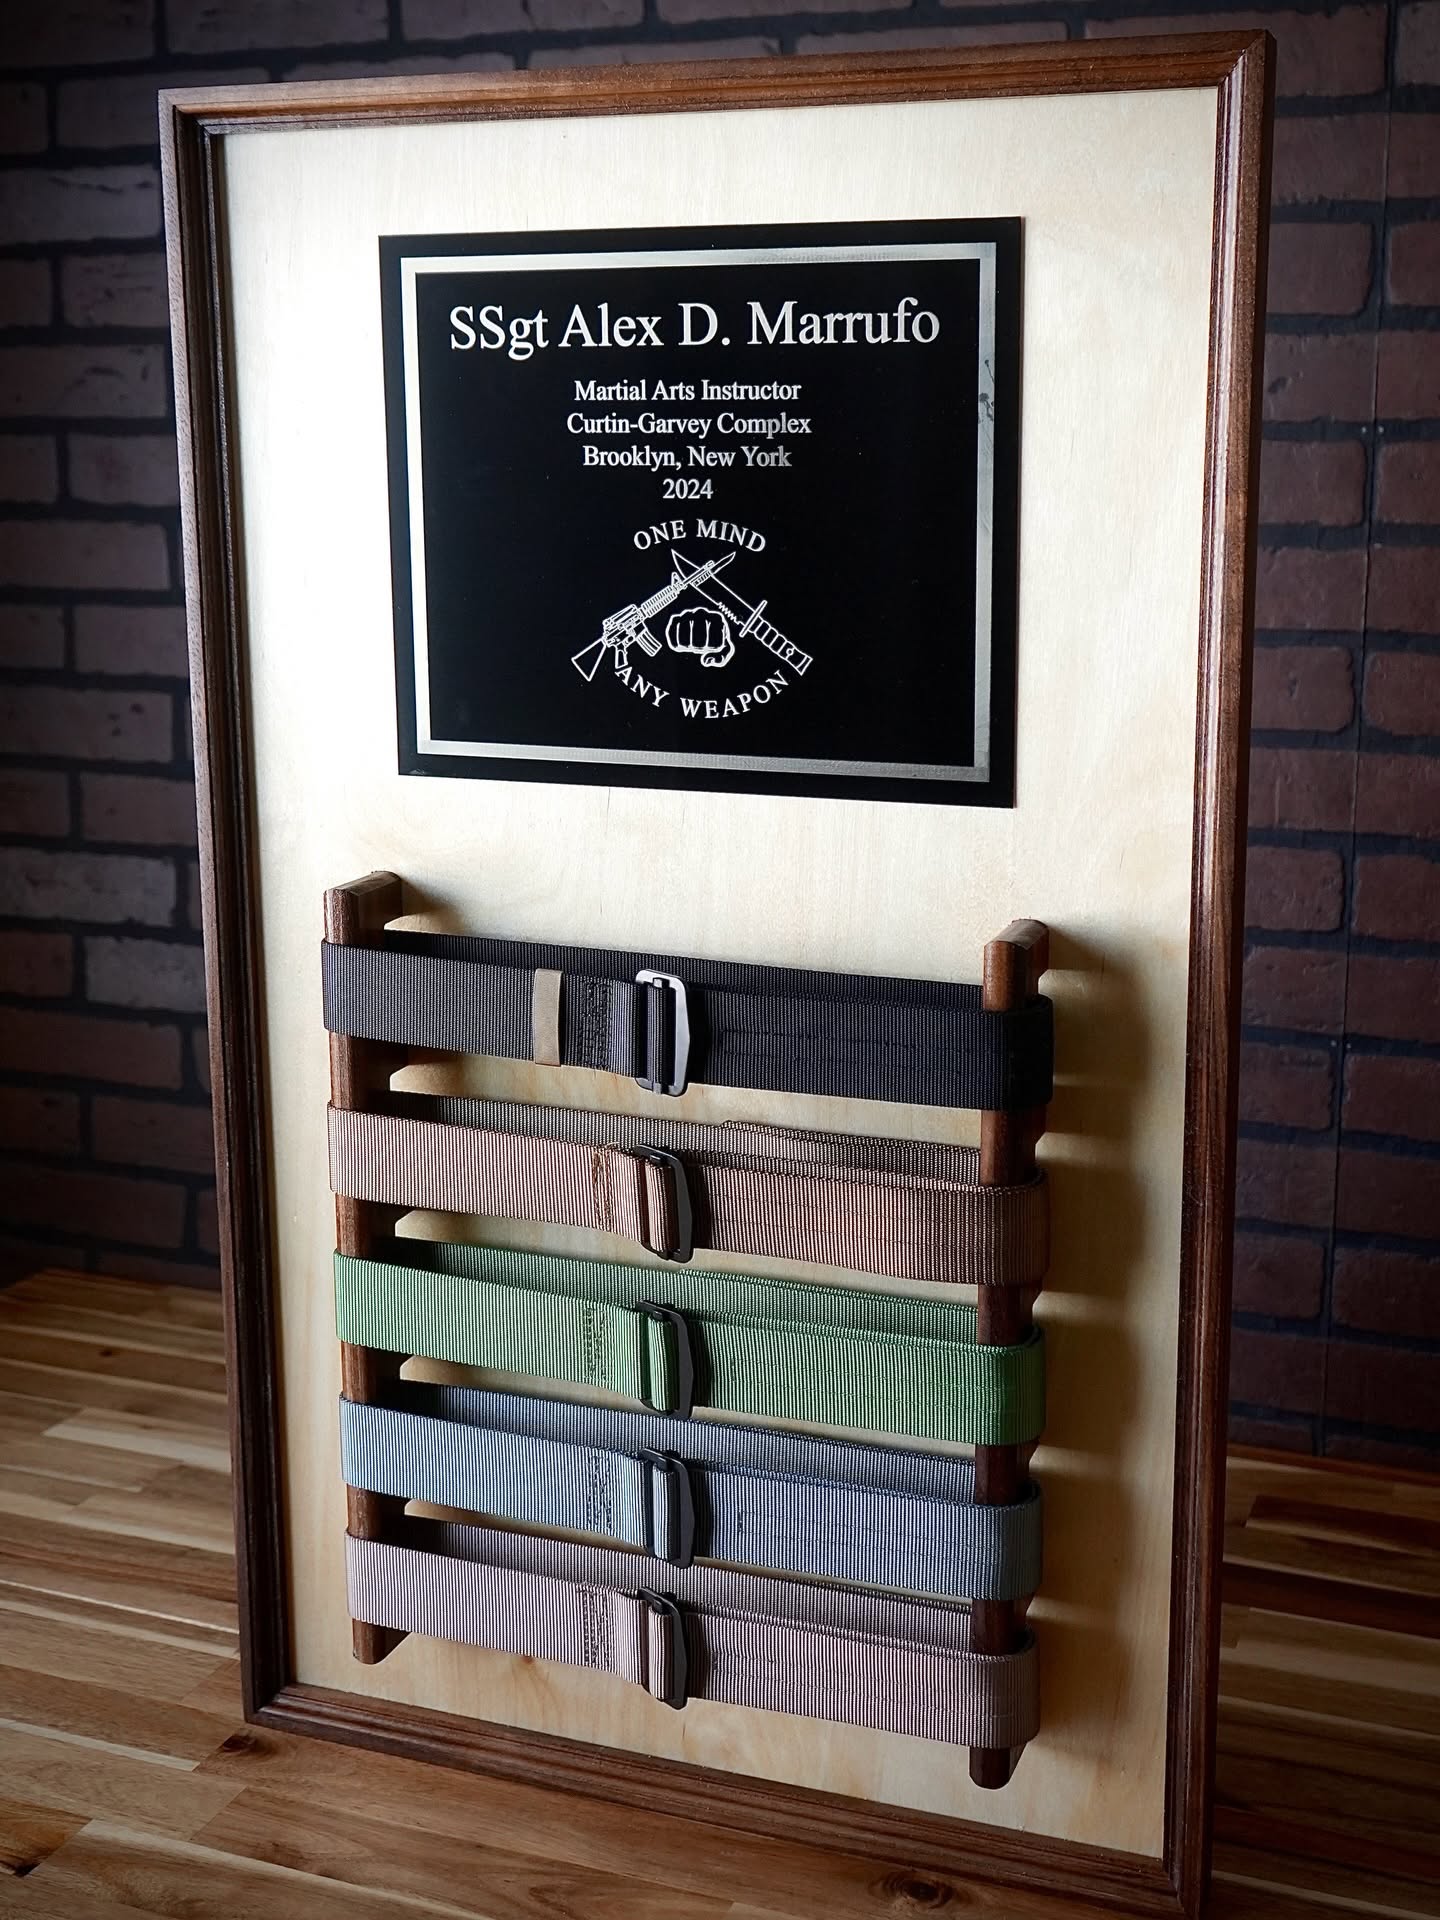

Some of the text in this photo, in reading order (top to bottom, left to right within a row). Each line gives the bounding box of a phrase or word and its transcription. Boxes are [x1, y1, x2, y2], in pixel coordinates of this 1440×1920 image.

[450, 297, 940, 360] SSgt Alex D. Marrufo
[574, 379, 802, 401] Martial Arts Instructor
[567, 412, 812, 440] Curtin-Garvey Complex
[583, 445, 793, 472] Brooklyn, New York
[663, 478, 714, 499] 2024
[634, 519, 766, 552] ONE MIND
[615, 666, 789, 718] ANY WEAPON
